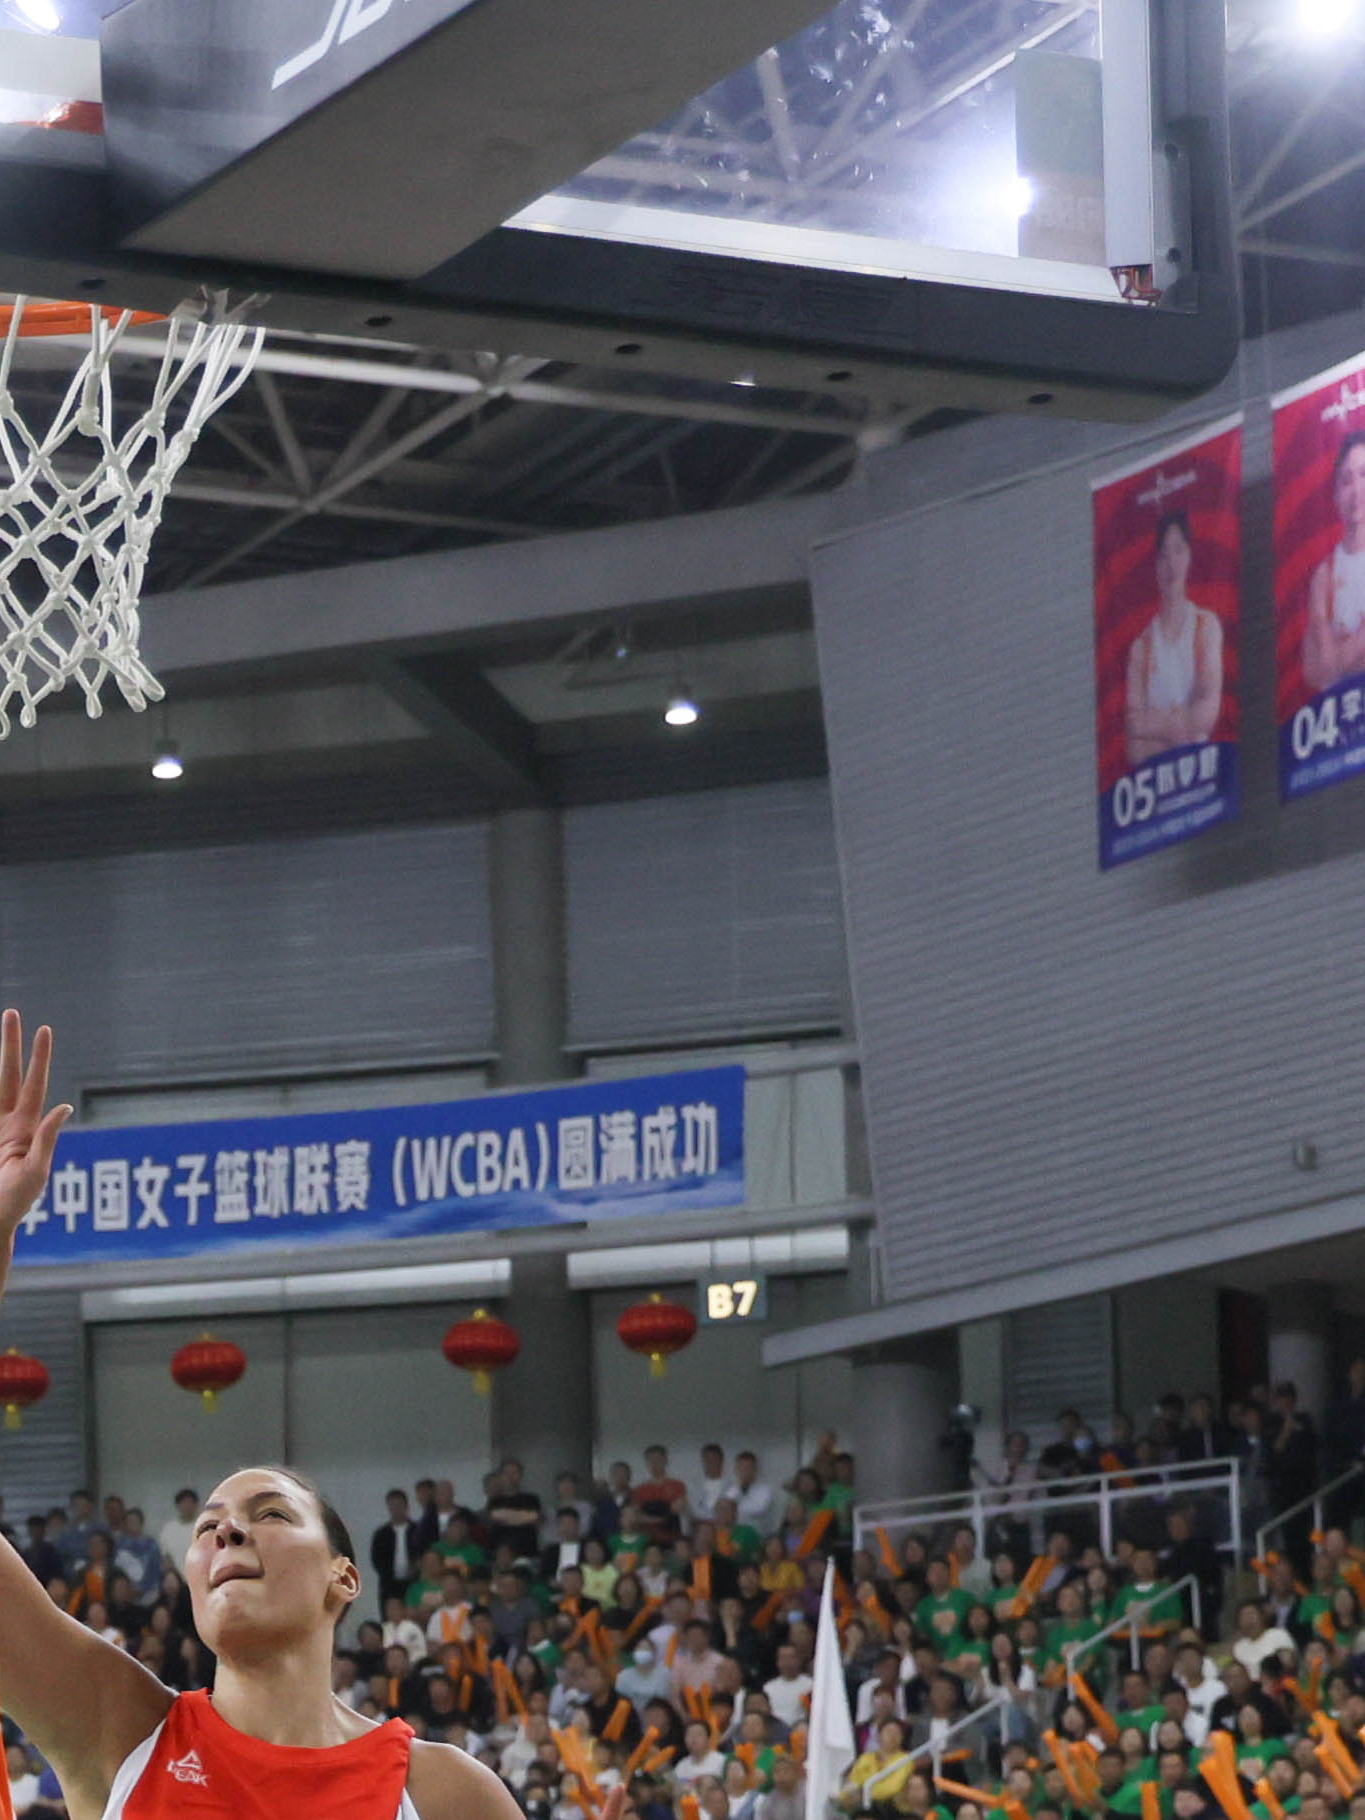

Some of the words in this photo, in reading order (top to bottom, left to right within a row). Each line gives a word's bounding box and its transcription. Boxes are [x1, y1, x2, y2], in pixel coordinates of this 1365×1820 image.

[1292, 697, 1339, 760] 04
[1113, 771, 1155, 828] 05
[707, 1280, 758, 1319] B7
